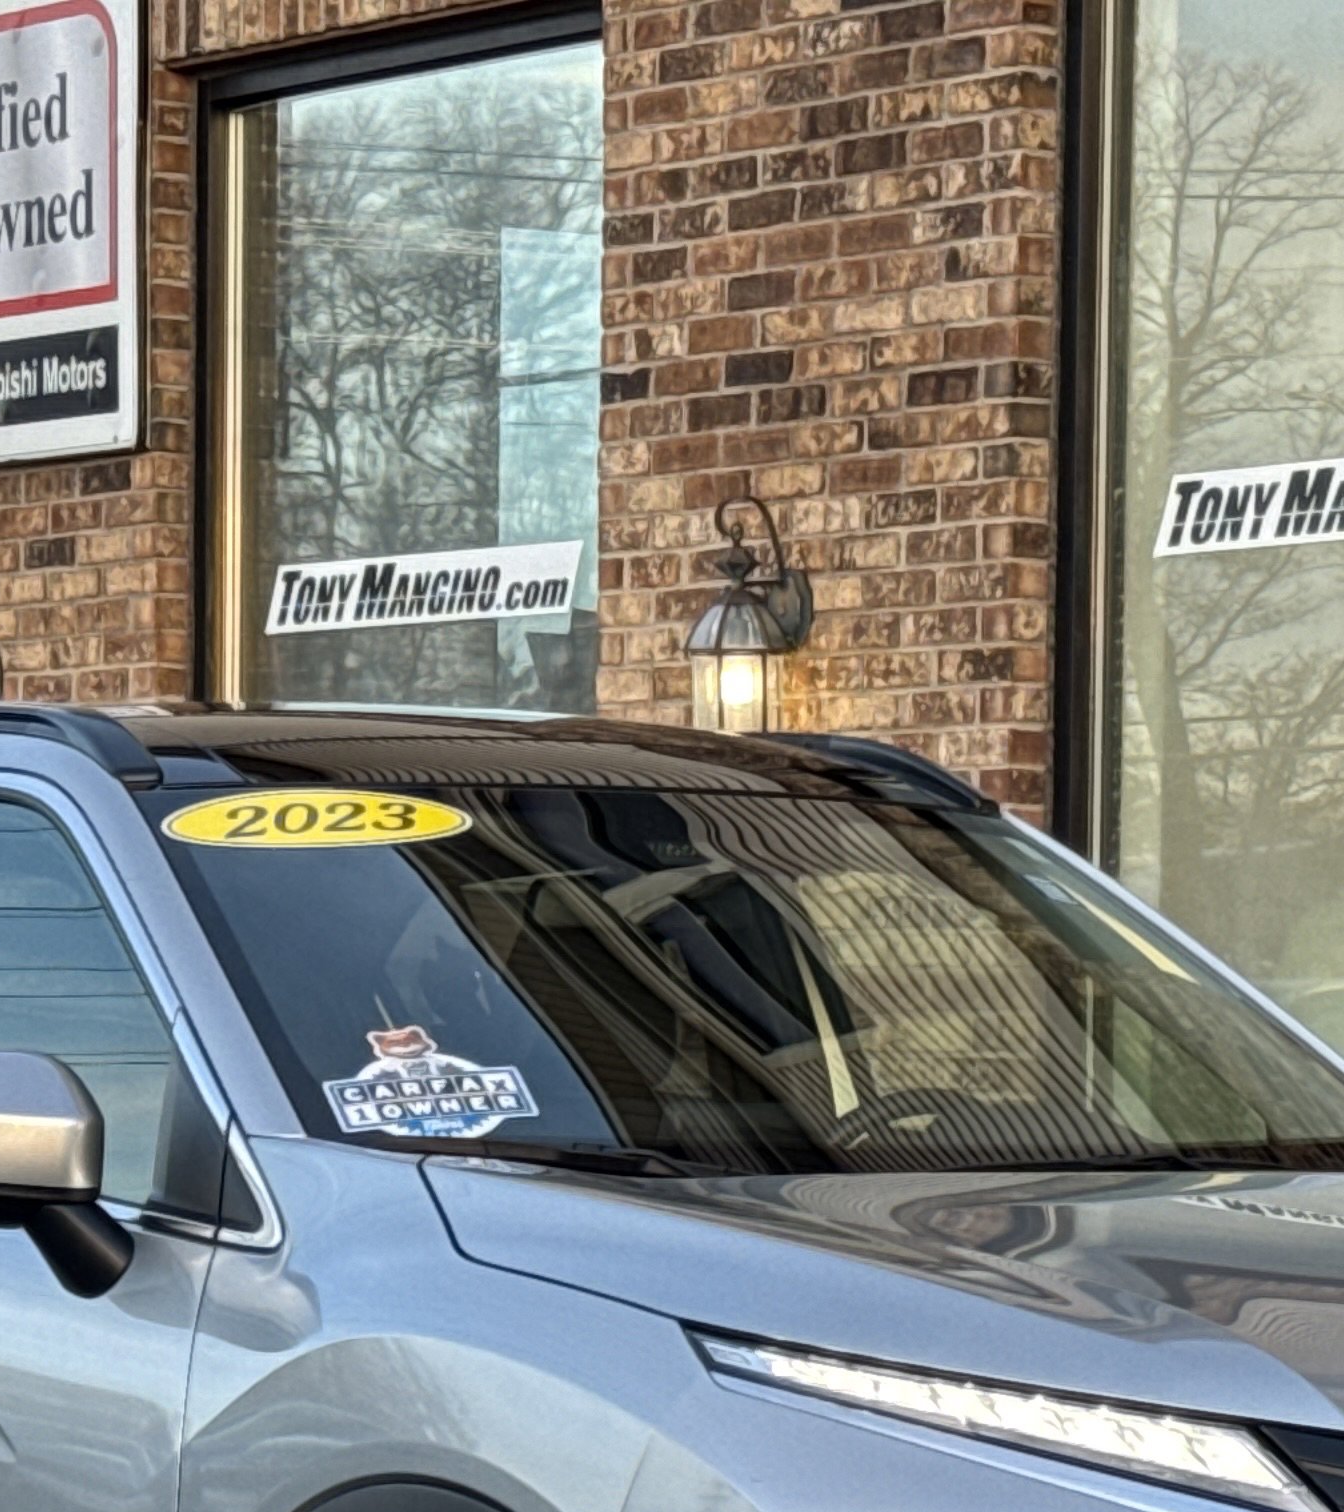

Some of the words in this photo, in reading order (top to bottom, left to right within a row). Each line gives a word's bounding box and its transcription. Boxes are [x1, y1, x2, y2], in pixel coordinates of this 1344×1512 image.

[43, 354, 107, 396] Motors
[224, 801, 417, 840] 2023
[342, 1076, 513, 1102] CARFAX
[381, 1094, 522, 1119] OWNER
